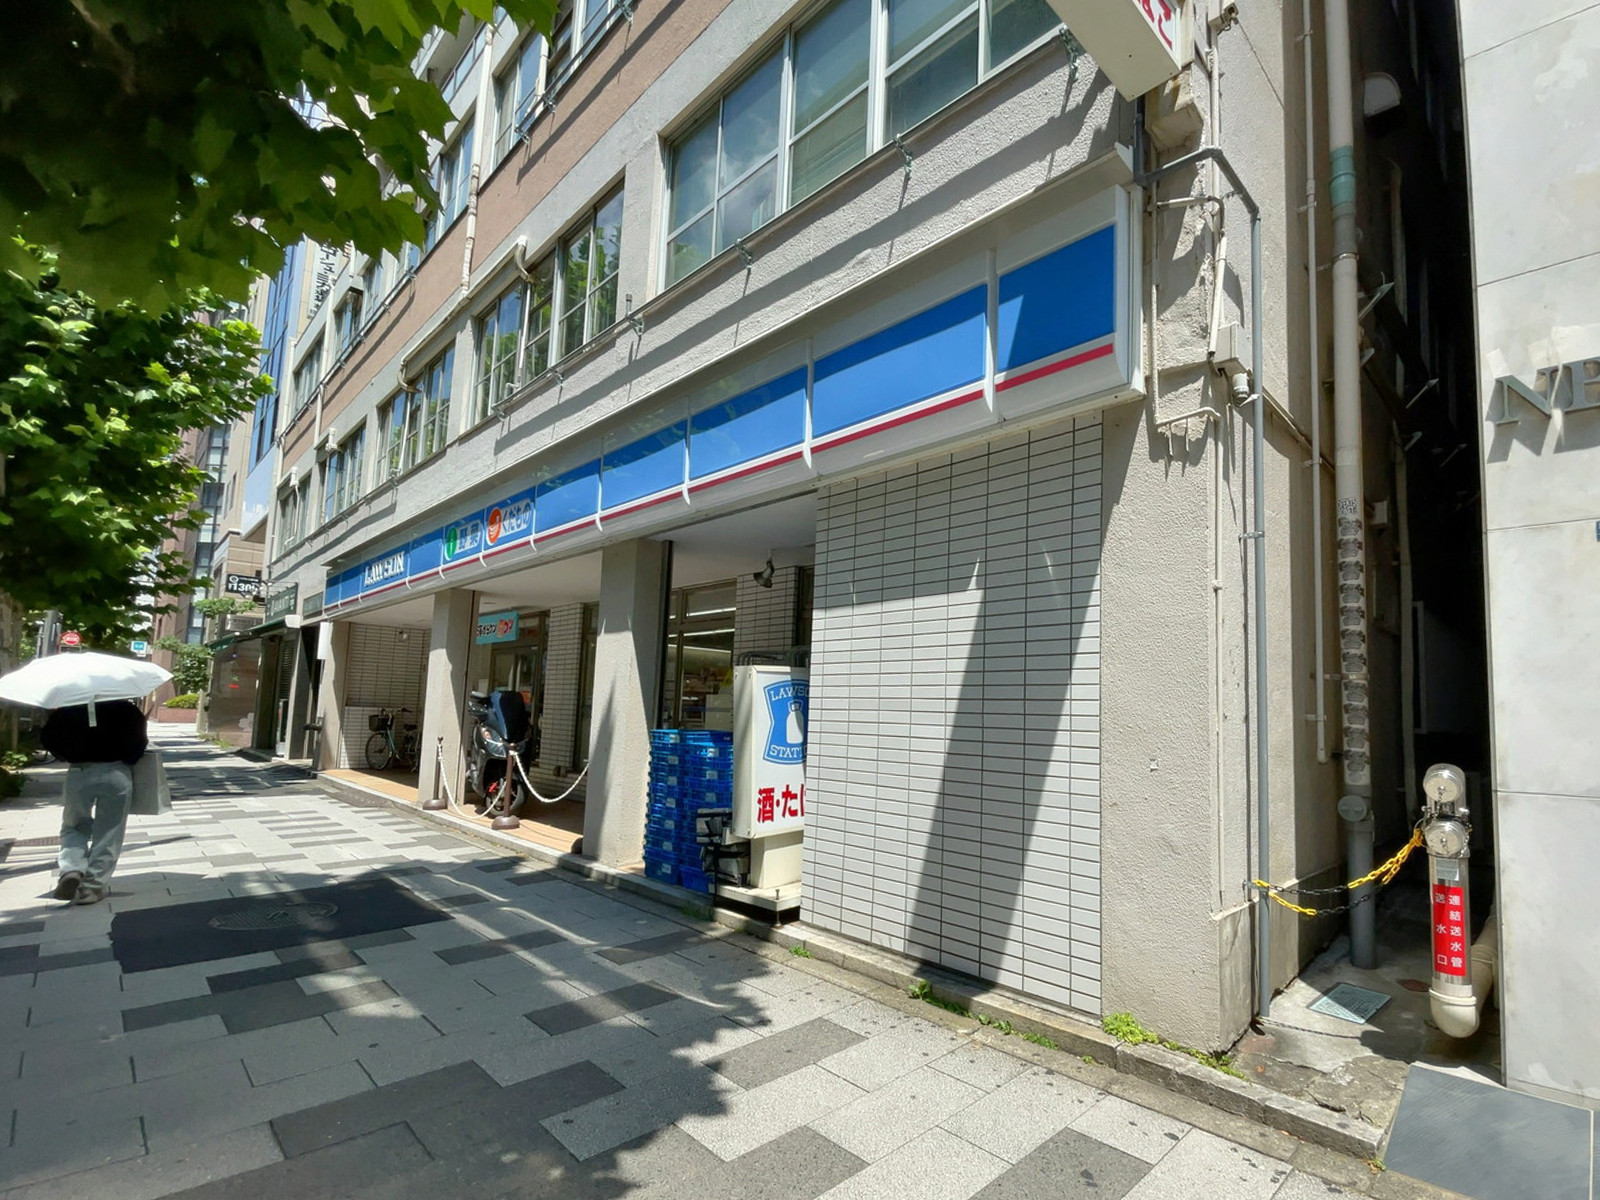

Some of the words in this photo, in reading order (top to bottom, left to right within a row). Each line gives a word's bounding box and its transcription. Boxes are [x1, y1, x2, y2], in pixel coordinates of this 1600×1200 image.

[364, 551, 404, 586] LAWSON
[1436, 893, 1447, 965] 送水口
[1448, 895, 1462, 967] 連結送水管
